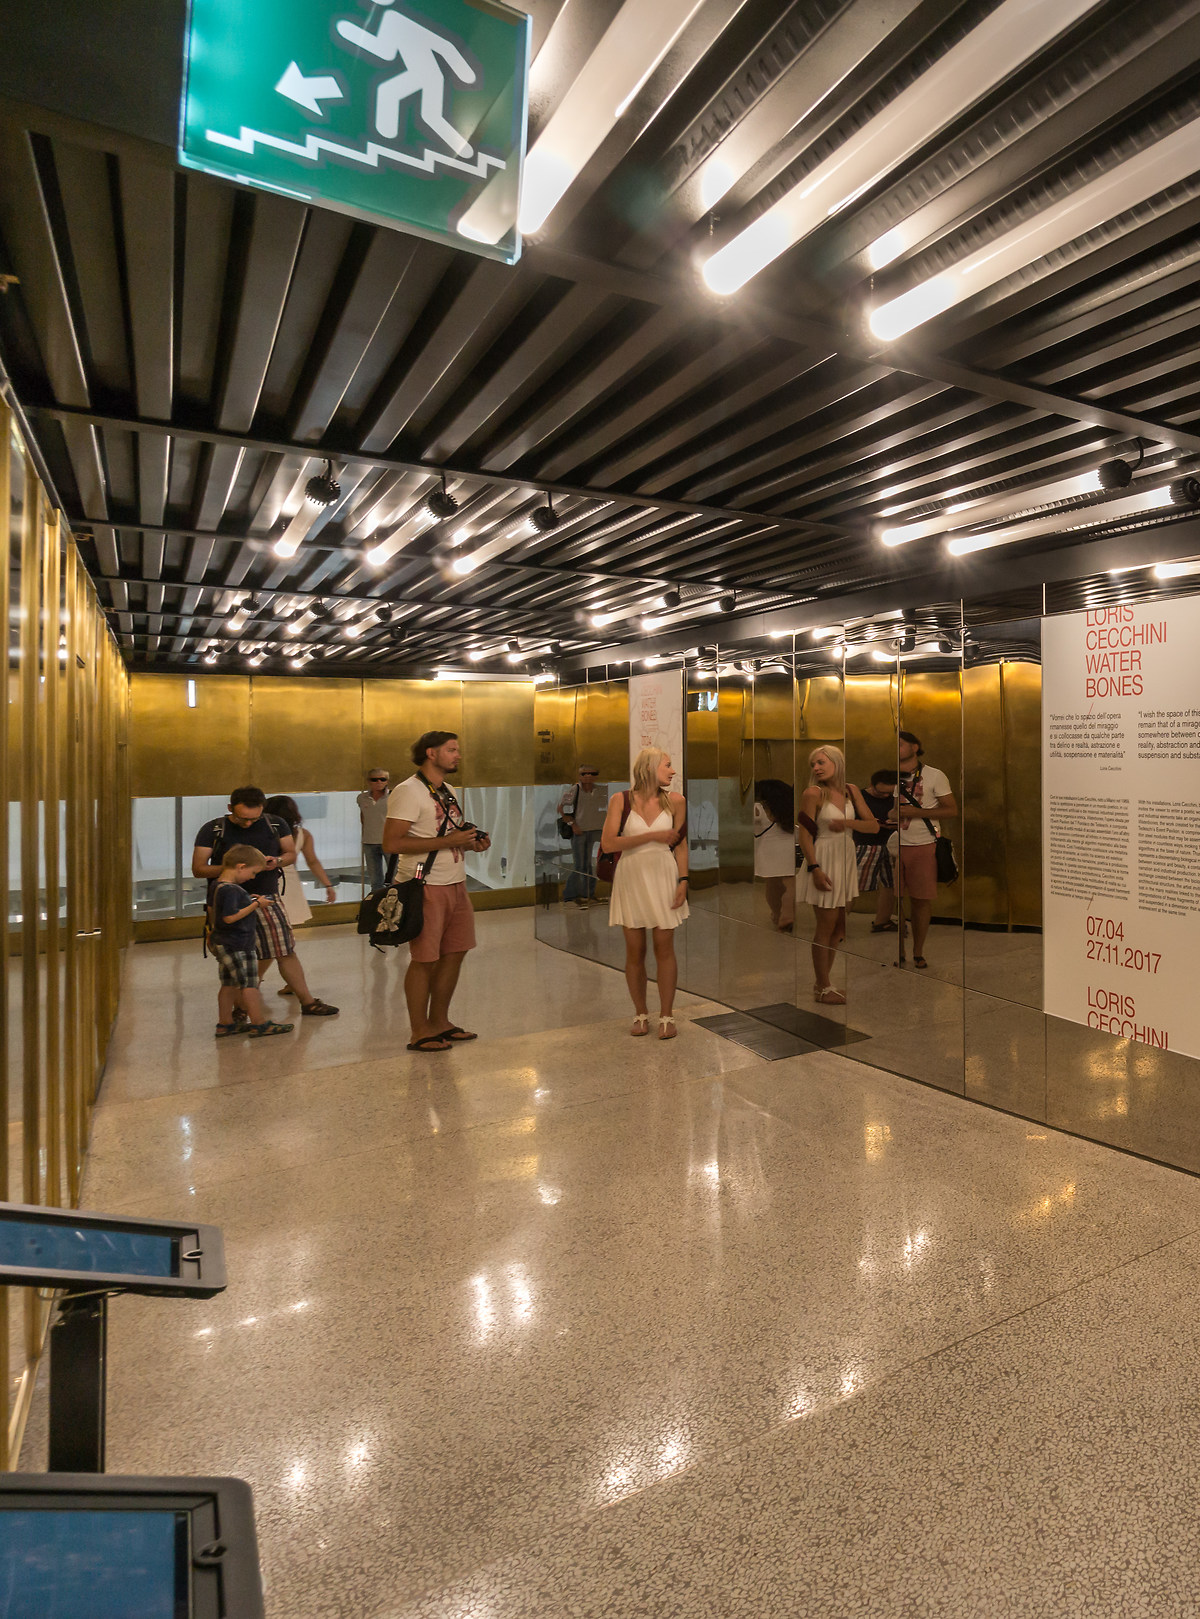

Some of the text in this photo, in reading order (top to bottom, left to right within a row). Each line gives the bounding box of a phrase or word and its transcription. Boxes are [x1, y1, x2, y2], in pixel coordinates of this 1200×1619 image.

[1086, 605, 1134, 626] LORIS
[1086, 622, 1167, 650] CECCHINI
[1086, 650, 1142, 674] WATER
[1086, 674, 1144, 698] BONES
[1086, 916, 1124, 941] 07.04
[1086, 940, 1162, 974] 27.11.2017
[1088, 986, 1135, 1018] LORIS
[1088, 1011, 1168, 1050] CECCHINI
